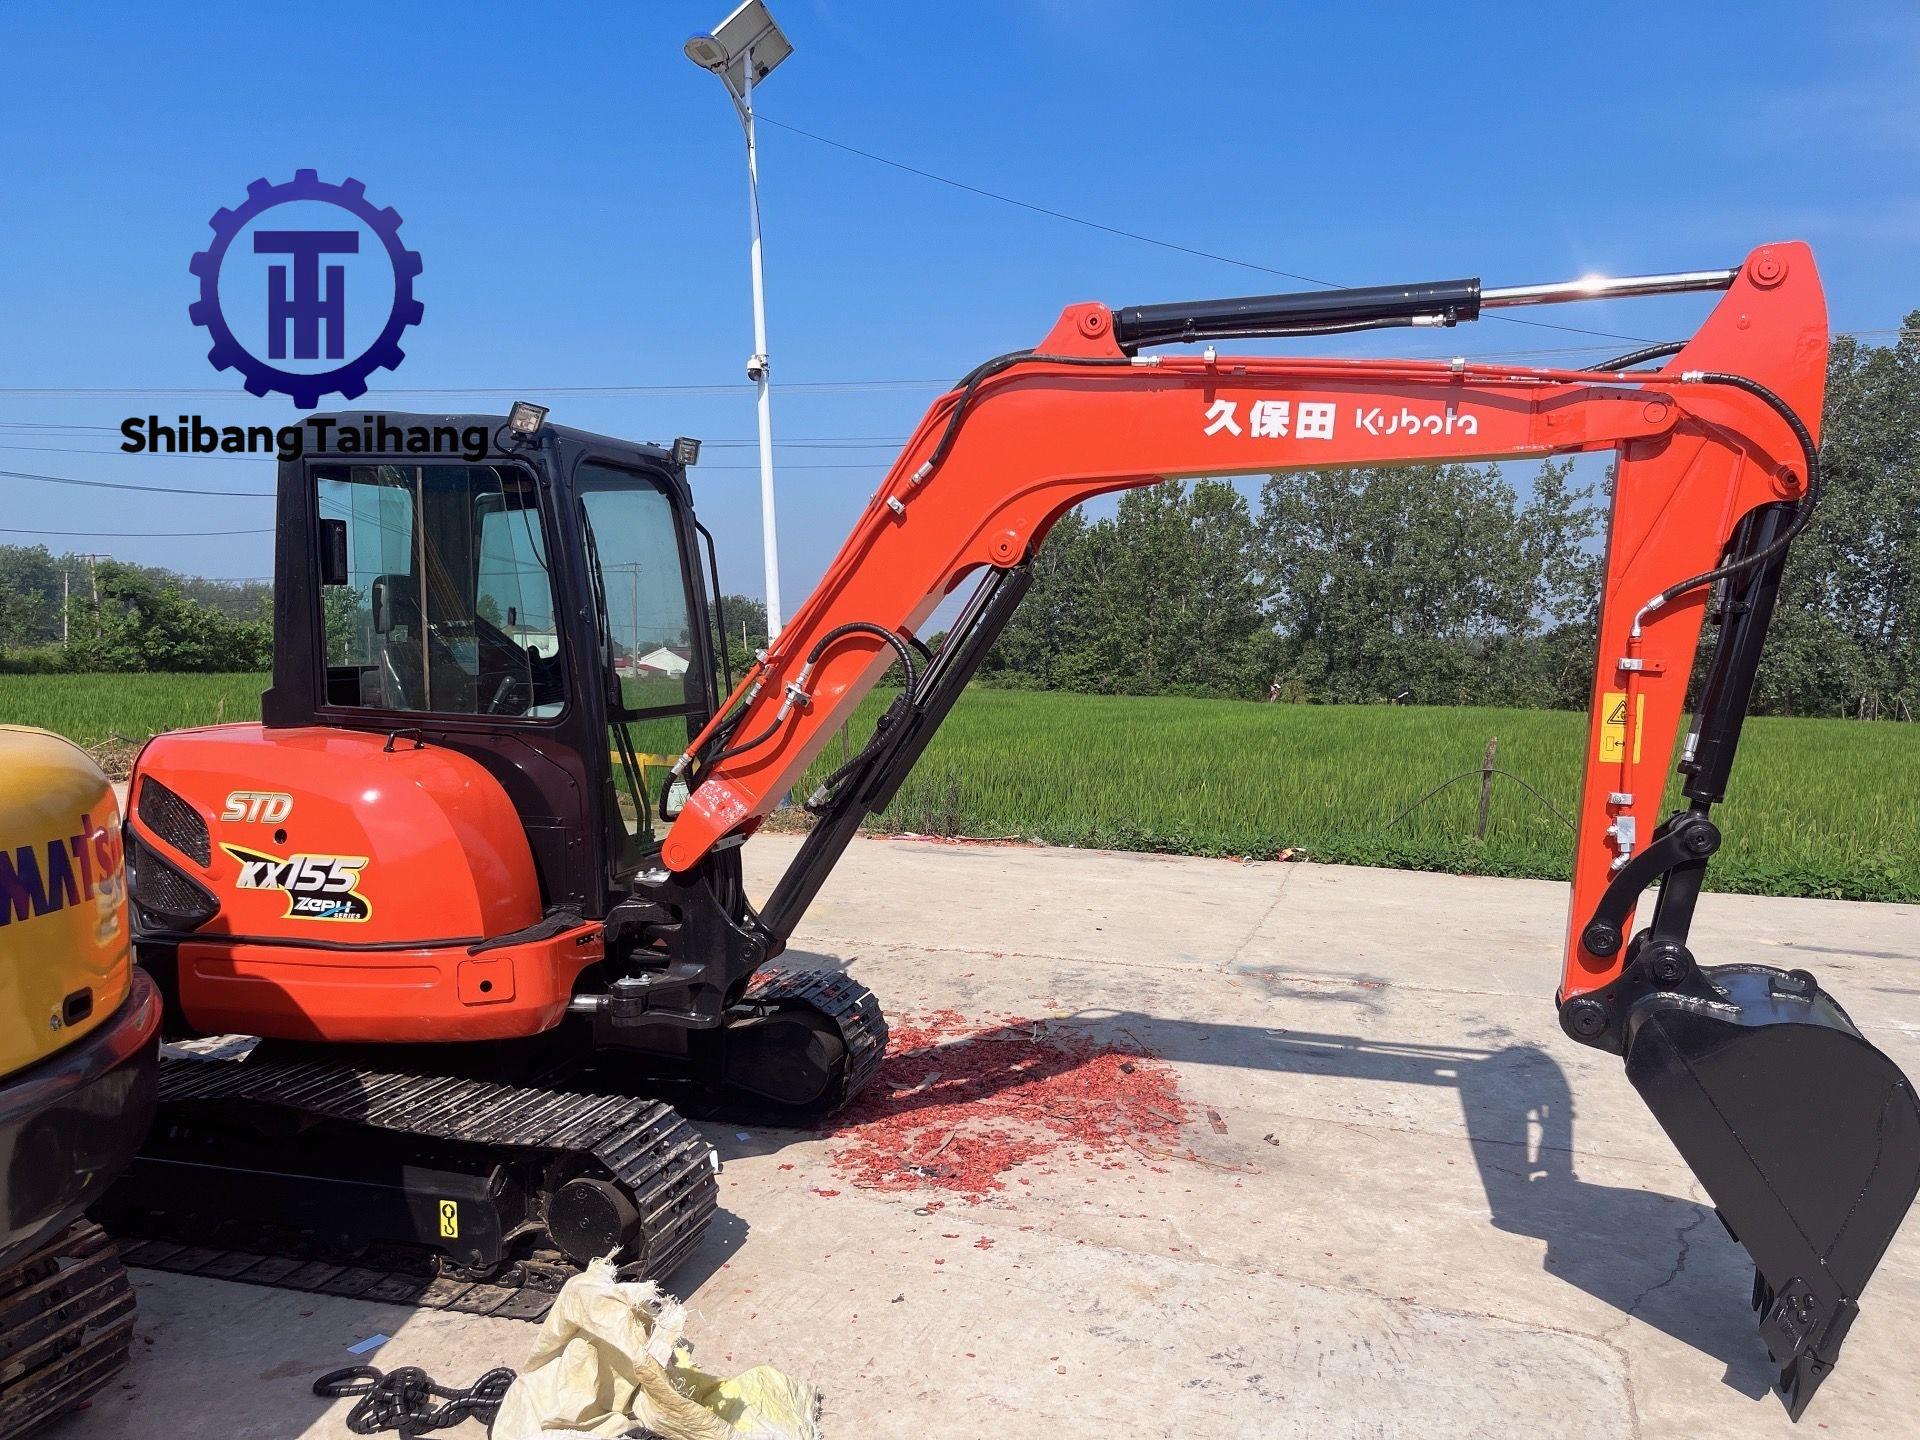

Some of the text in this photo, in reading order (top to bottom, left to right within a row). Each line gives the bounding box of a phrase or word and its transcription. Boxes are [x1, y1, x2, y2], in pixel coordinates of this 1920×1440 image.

[1203, 399, 1478, 439] 久保田 Kubota
[221, 791, 294, 823] STD
[237, 856, 369, 893] KX155
